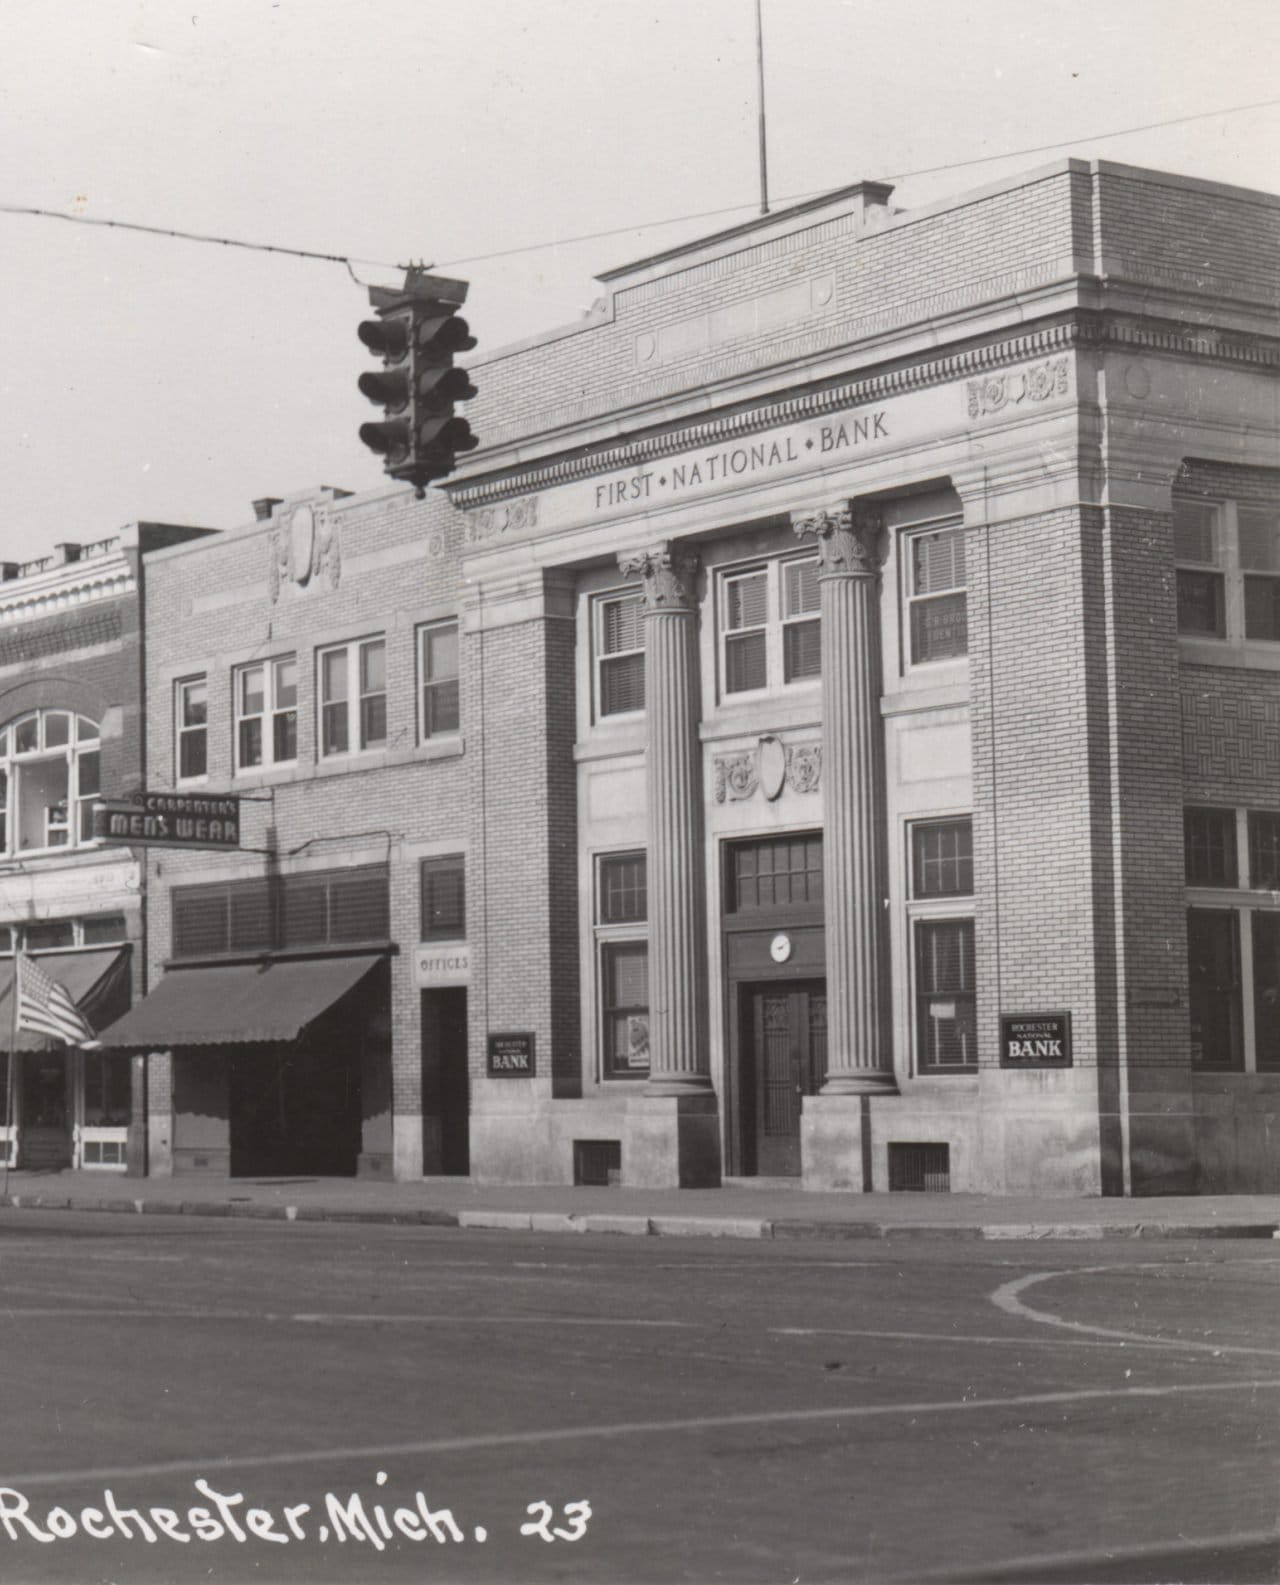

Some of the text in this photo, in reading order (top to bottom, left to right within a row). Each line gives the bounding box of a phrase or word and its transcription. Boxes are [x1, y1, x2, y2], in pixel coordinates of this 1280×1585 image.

[595, 411, 889, 508] FIRST NATIONAL BANK
[176, 818, 238, 841] WEAR
[420, 957, 468, 971] OFFICES
[1008, 1040, 1062, 1057] BANK
[492, 1054, 529, 1070] BANK
